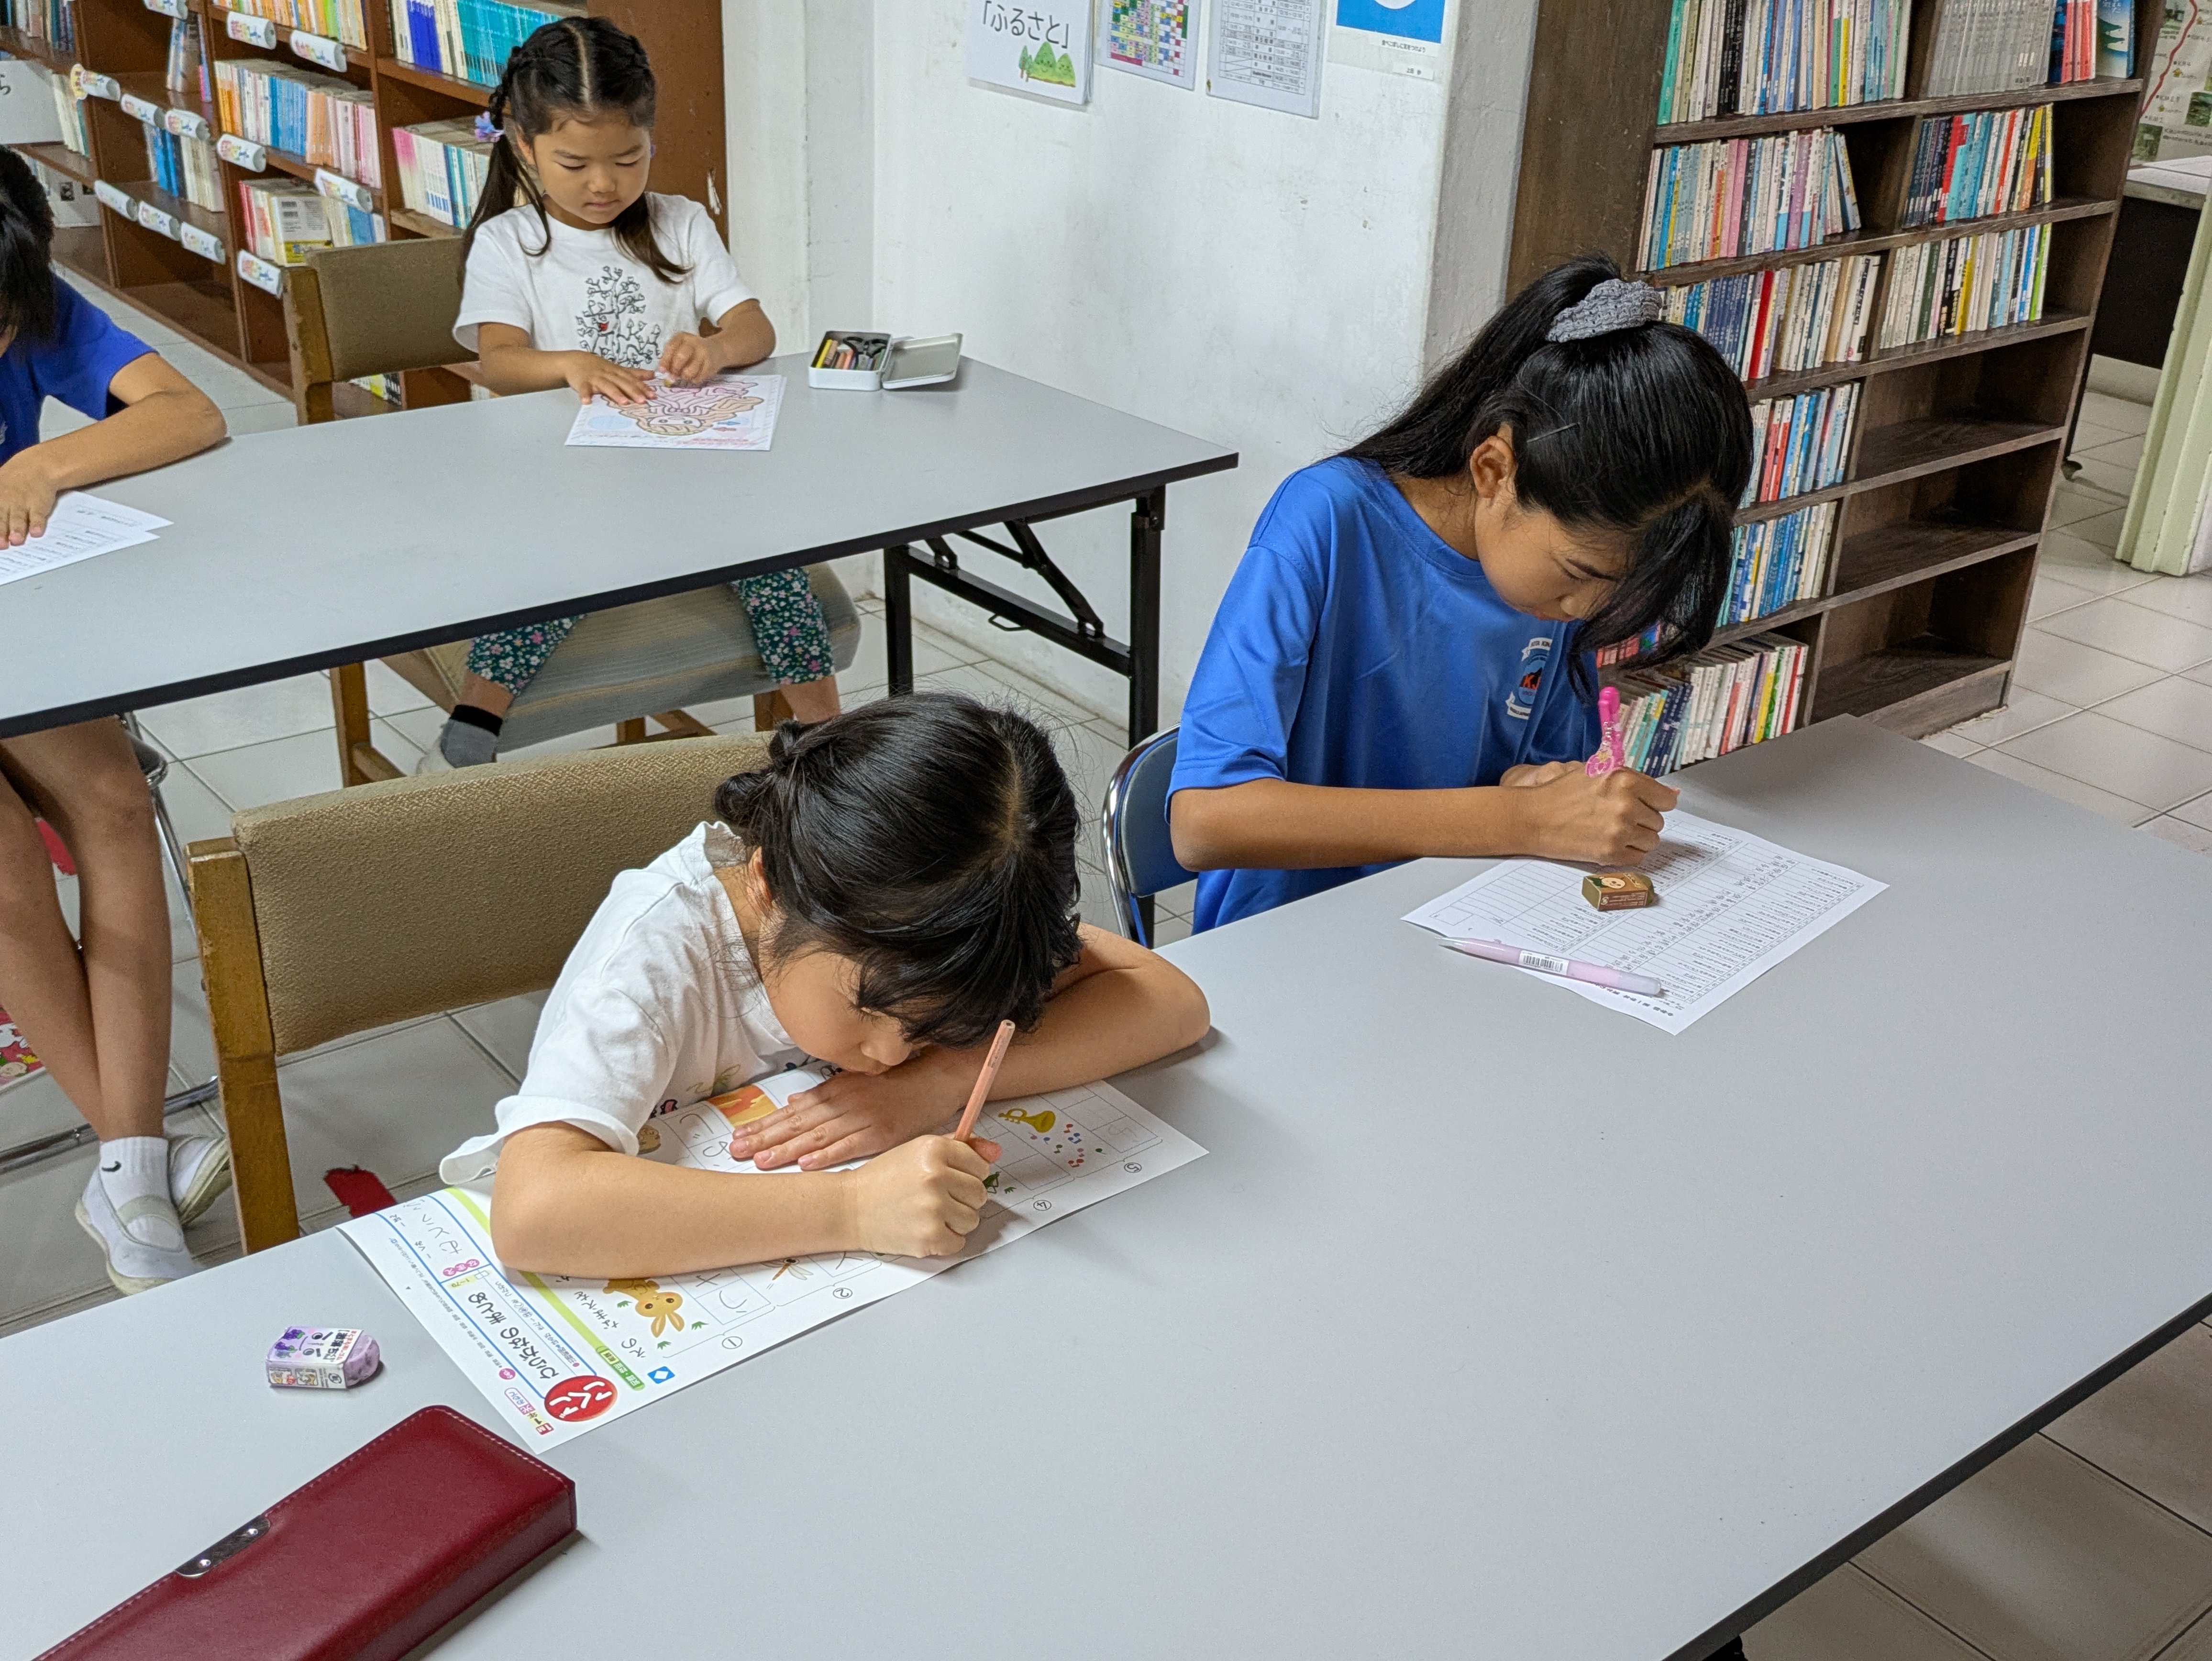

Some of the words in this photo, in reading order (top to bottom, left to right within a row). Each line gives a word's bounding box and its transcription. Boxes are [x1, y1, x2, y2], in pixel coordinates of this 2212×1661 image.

[983, 0, 1069, 48] 「ふるさと」
[468, 1292, 507, 1324] まとめ
[575, 1291, 619, 1330] なまえを
[500, 1327, 559, 1379] ひらがなの
[621, 1338, 646, 1358] えの
[549, 1381, 613, 1419] こくご
